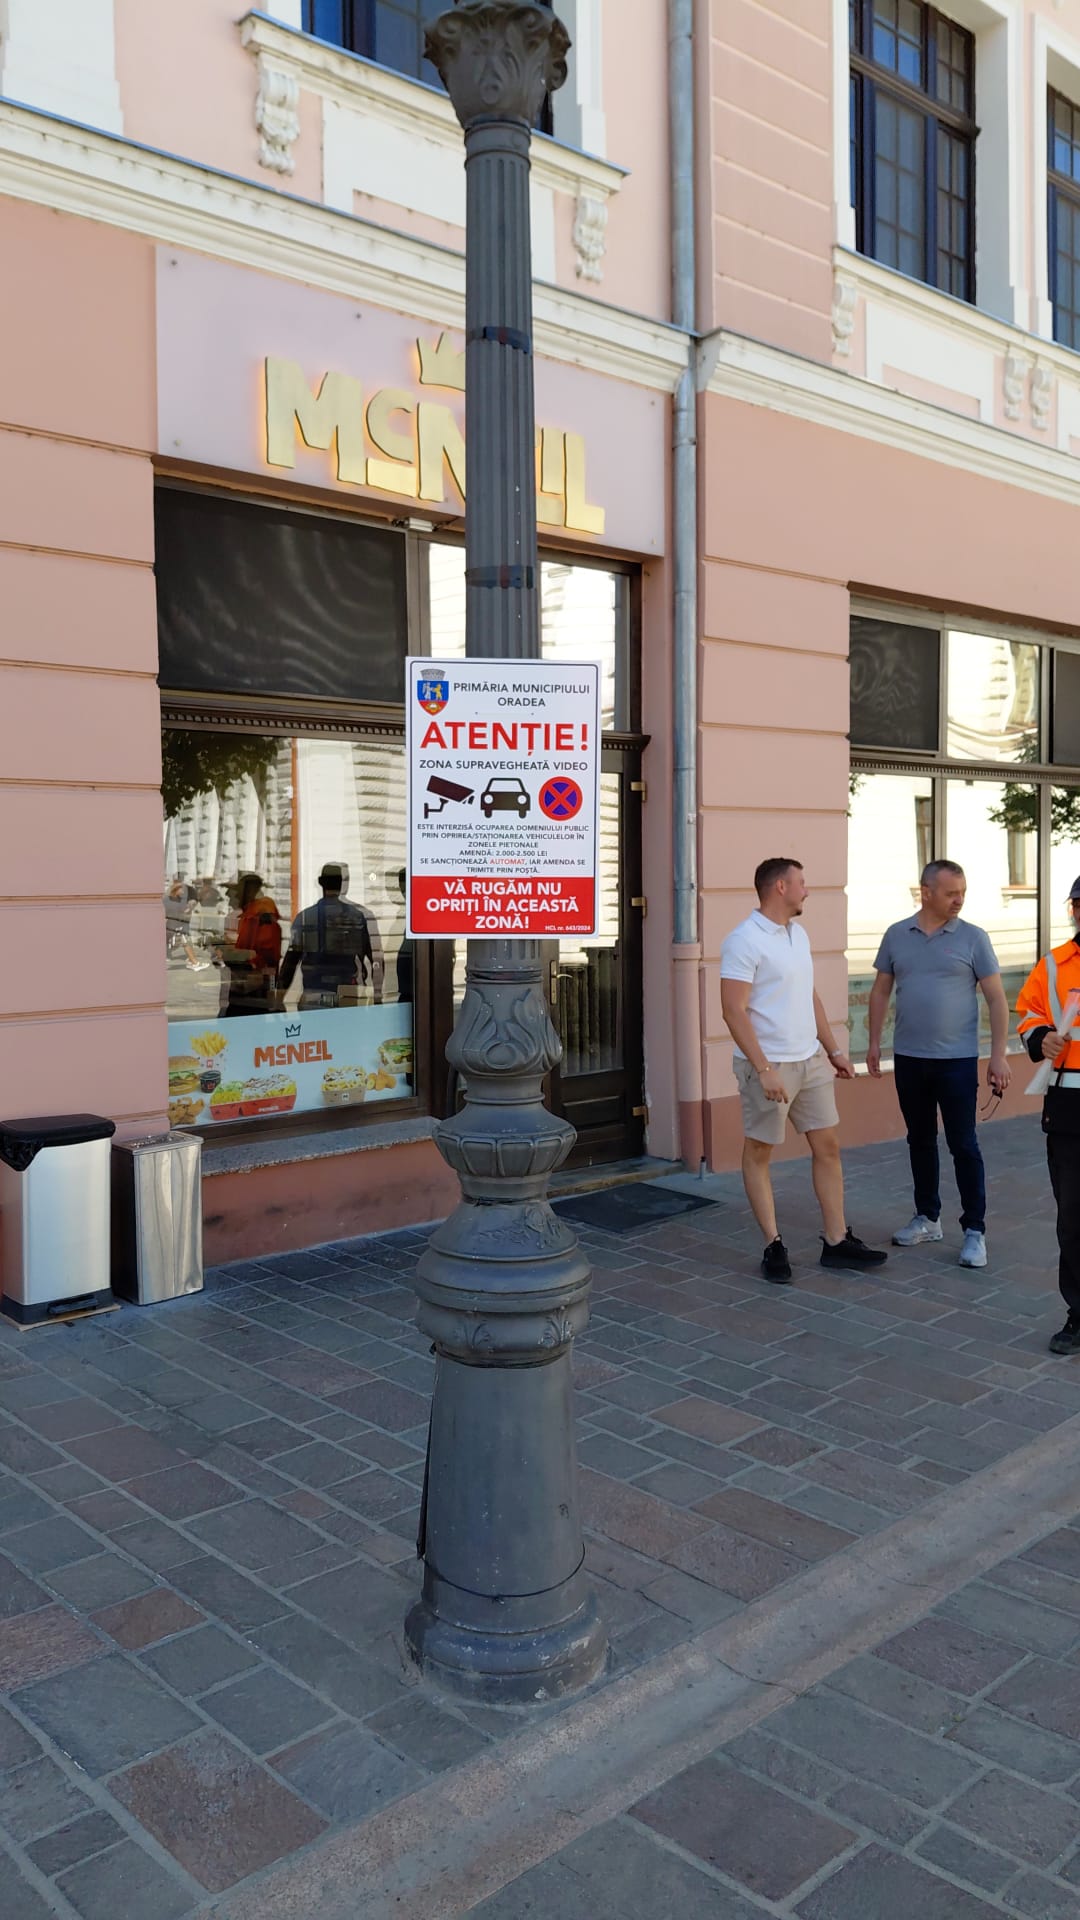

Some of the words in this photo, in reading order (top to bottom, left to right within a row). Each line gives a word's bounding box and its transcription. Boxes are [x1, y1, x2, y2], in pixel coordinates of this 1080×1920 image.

[454, 682, 508, 692] PRIMĂRIA
[512, 684, 589, 694] MUNICIPIULUI
[498, 697, 546, 706] ORADEA
[421, 721, 588, 756] ATENȚIE!
[420, 760, 452, 769] ZONA
[456, 760, 549, 770] SUPRAVEGHEATĂ
[553, 762, 588, 770] VIDEO
[577, 832, 584, 840] ÎN
[444, 879, 466, 894] VĂ
[472, 880, 531, 895] RUGĂM
[538, 882, 561, 895] NU
[427, 899, 478, 915] OPRIȚI
[484, 897, 500, 912] ÎN
[507, 897, 578, 912] ACEASTĂ
[475, 914, 529, 929] ZONĂ!
